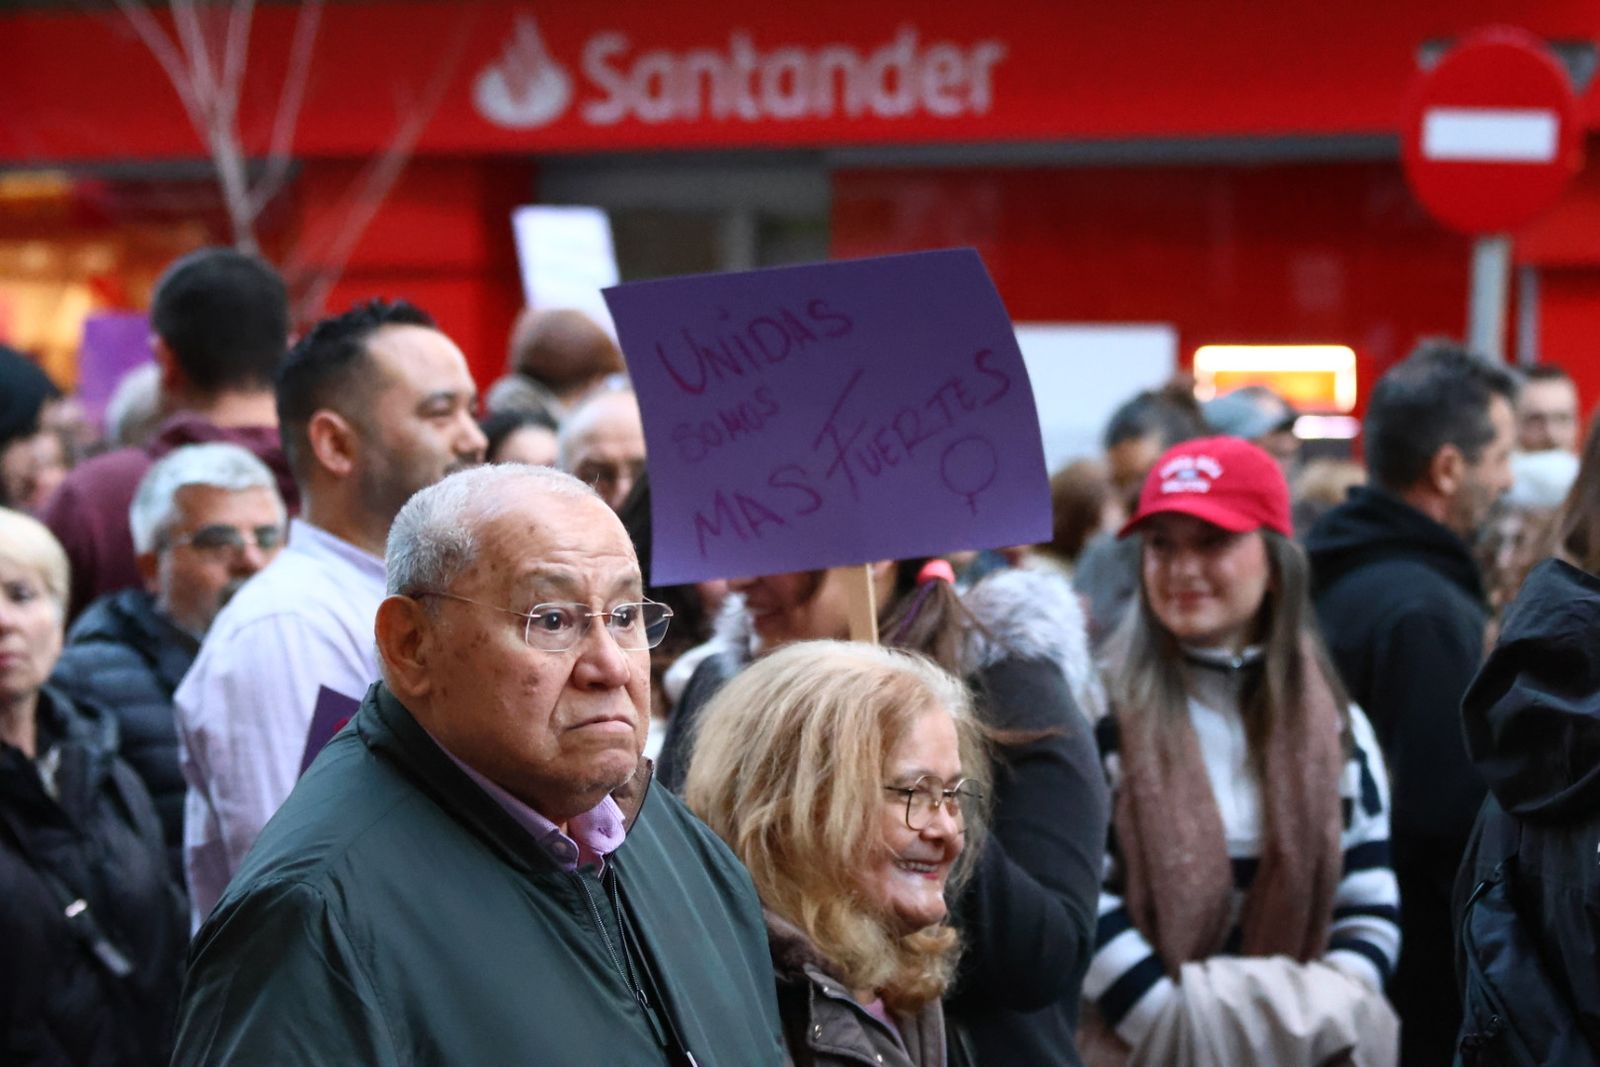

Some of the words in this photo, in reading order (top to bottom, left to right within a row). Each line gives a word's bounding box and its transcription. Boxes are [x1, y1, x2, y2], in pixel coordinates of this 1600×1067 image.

[581, 27, 1004, 124] Santander
[672, 386, 780, 463] SOMOS
[693, 464, 822, 556] MAS
[812, 347, 1011, 499] FUERTES
